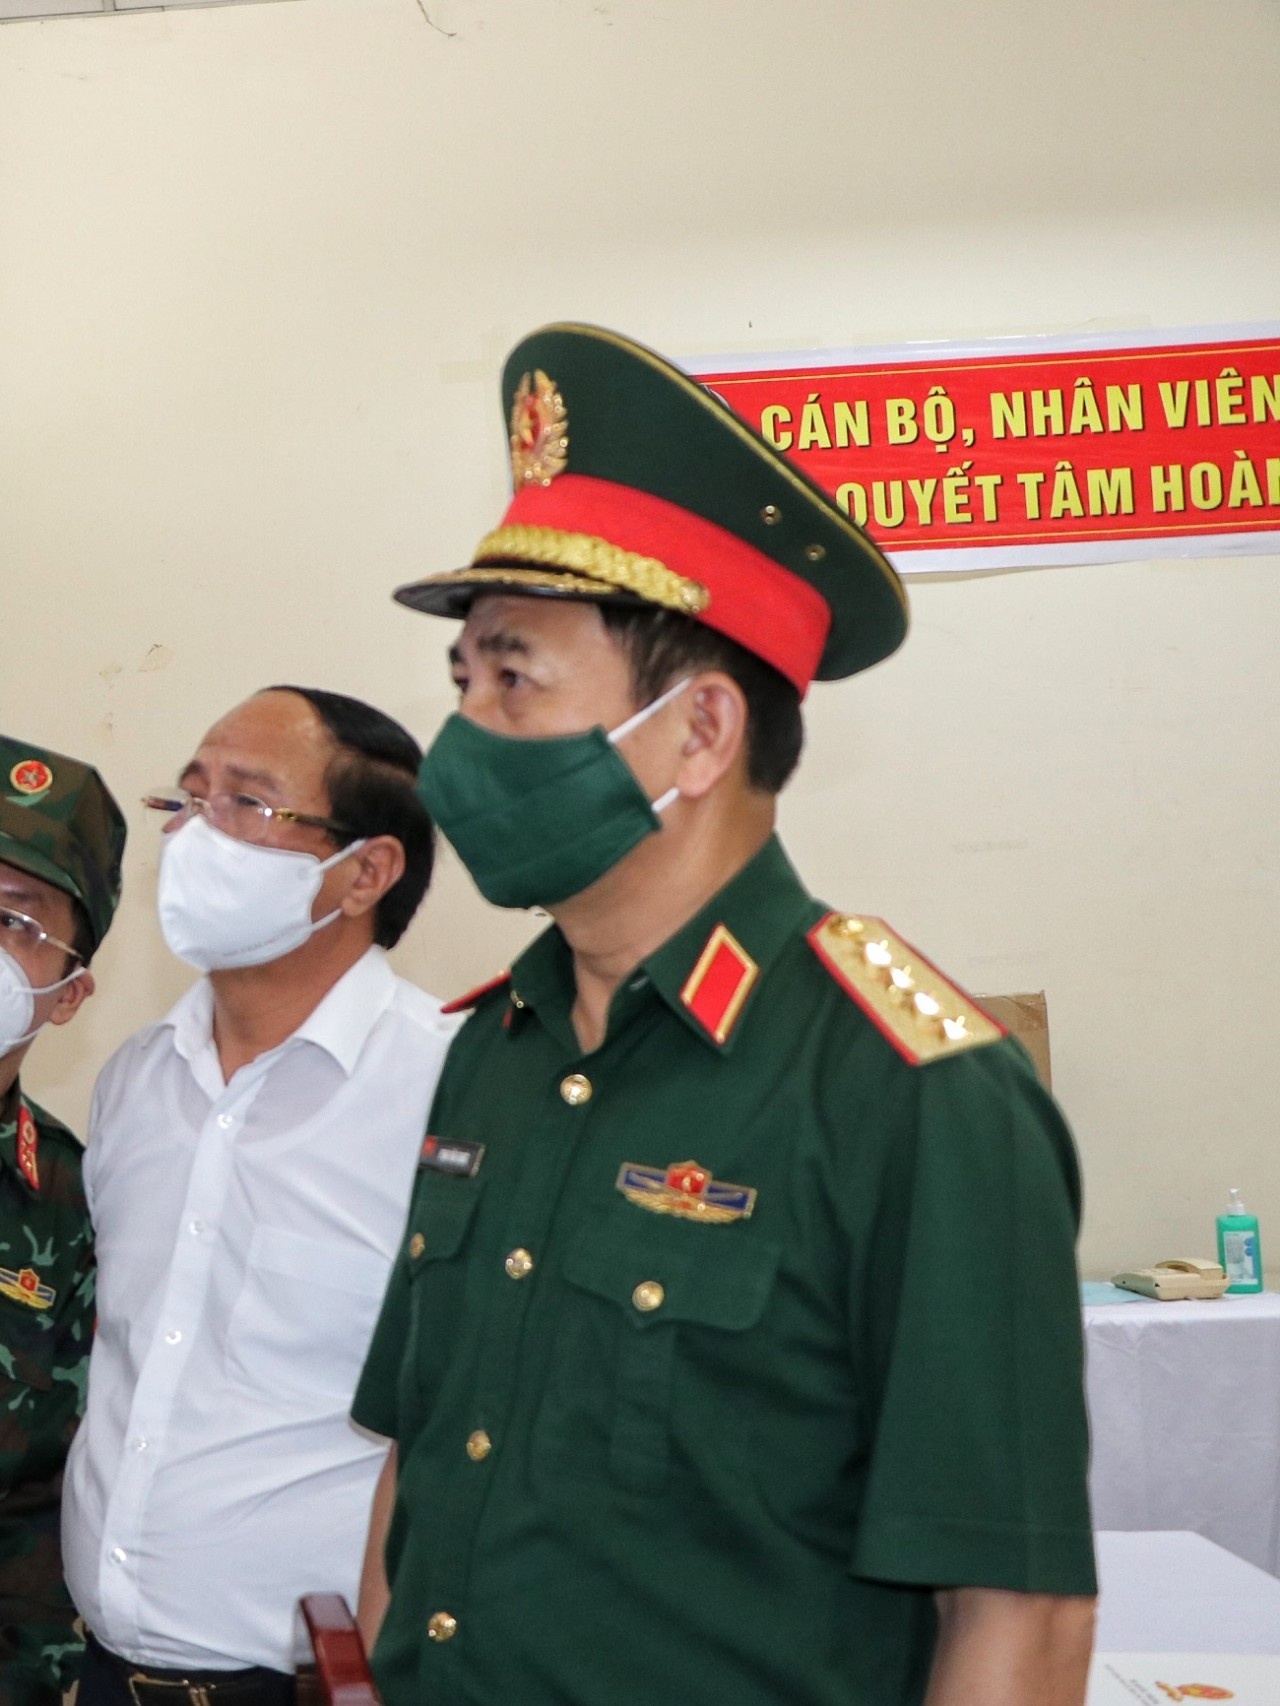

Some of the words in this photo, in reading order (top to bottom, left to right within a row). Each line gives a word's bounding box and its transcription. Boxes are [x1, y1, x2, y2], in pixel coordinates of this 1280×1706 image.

[761, 393, 871, 452] CÁN
[886, 385, 975, 453] BỘ,
[990, 377, 1144, 438] NHÂN
[1158, 367, 1280, 429] VIÊN
[1016, 461, 1134, 520] TÂM
